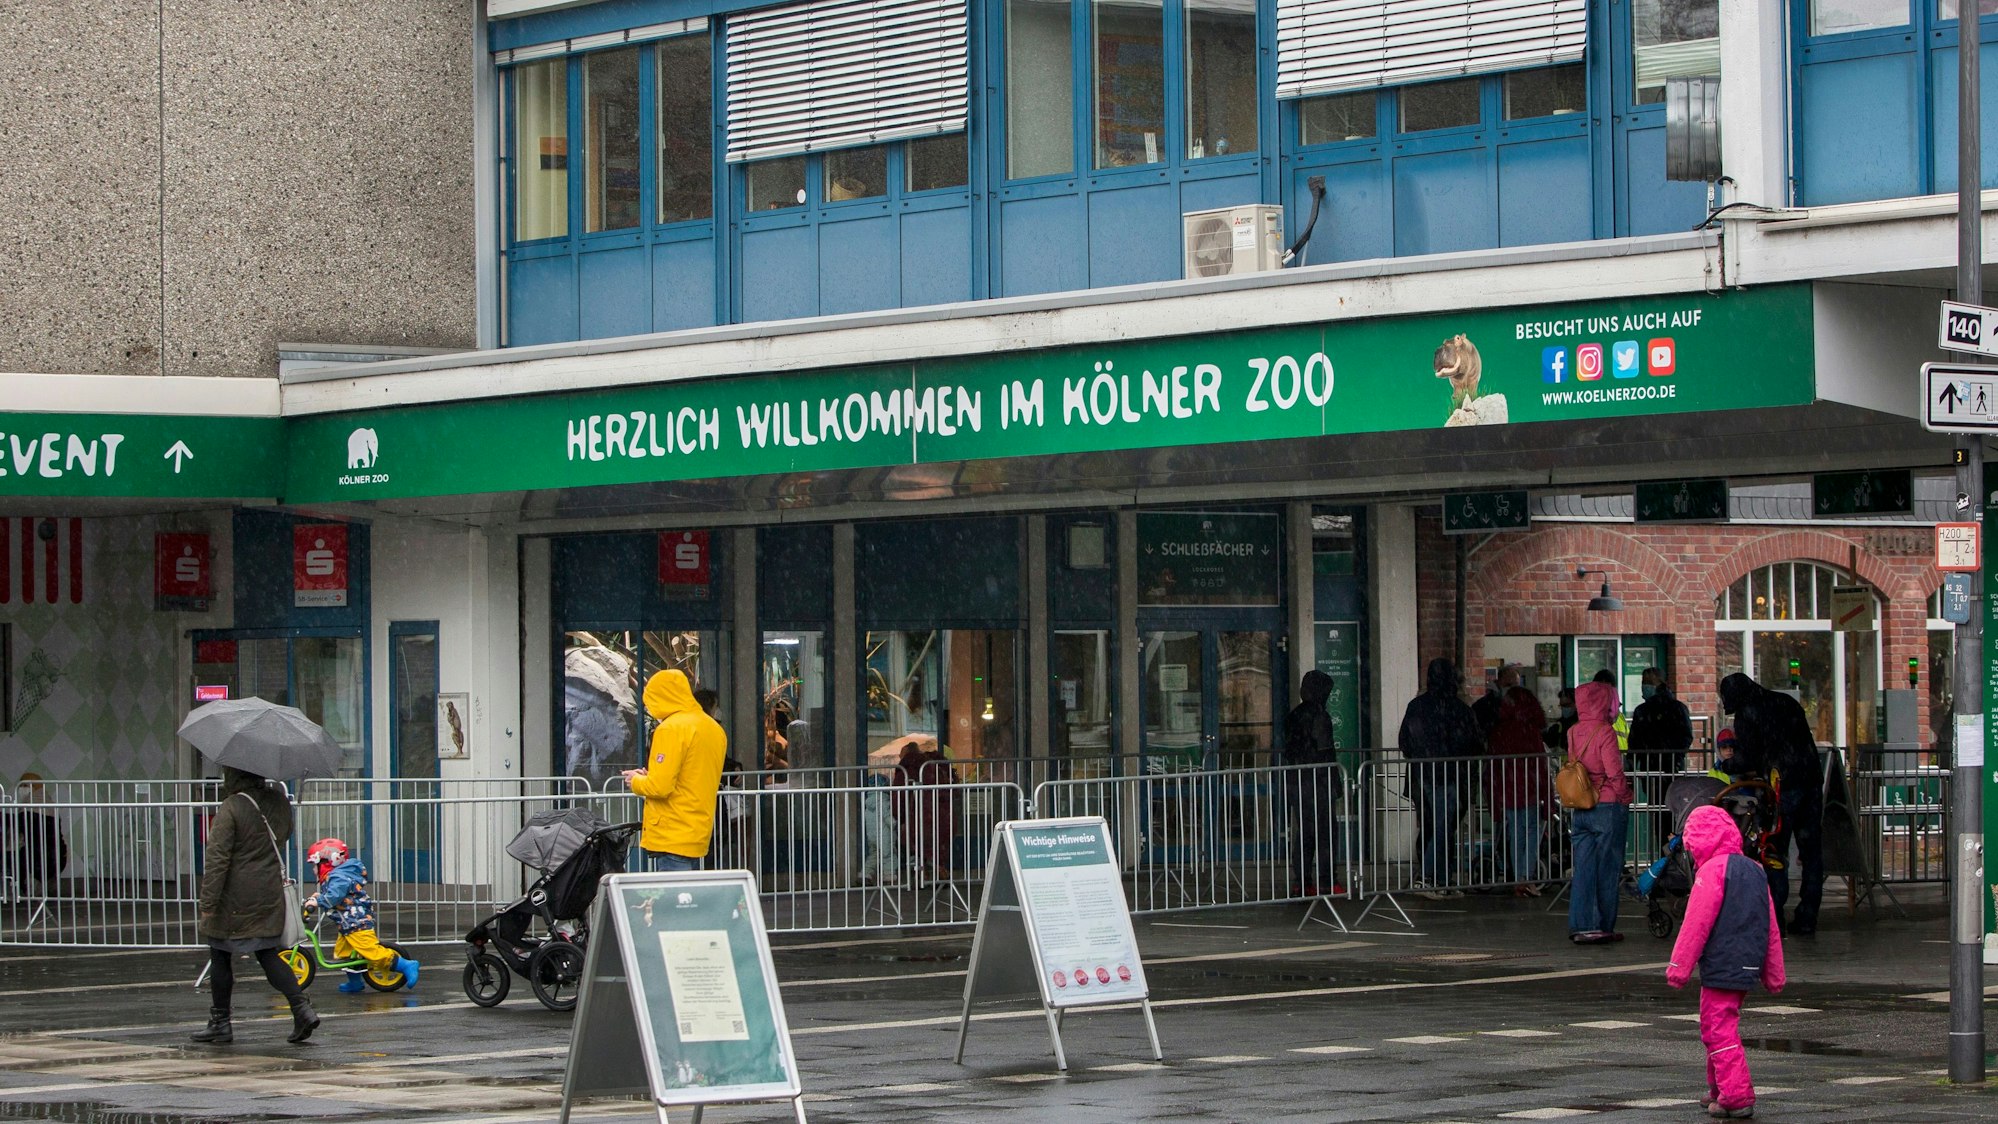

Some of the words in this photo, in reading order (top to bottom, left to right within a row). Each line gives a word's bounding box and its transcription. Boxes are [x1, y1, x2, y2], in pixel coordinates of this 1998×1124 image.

[1516, 319, 1583, 339] BESUCHT
[1588, 316, 1619, 334] UNS
[1623, 312, 1667, 332] AUCH
[1671, 310, 1702, 329] AUF
[1950, 316, 1980, 340] 140
[1542, 385, 1676, 406] WWW.KOELNERZOO.DE
[567, 407, 720, 461] HERZLICH
[736, 386, 981, 448] WILLKOMMEN
[1001, 379, 1044, 430] IM
[1063, 360, 1222, 426] KÖLNER
[1245, 352, 1335, 412] ZOO
[0, 432, 124, 478] VENT
[1956, 450, 1962, 463] 3
[338, 474, 370, 485] KÖLNER
[372, 473, 389, 483] ZOO
[1939, 528, 1961, 539] H200
[1161, 540, 1254, 556] SCHLIEßFÄCHER
[1022, 835, 1056, 848] Wichtige
[1057, 833, 1096, 845] Hinweise
